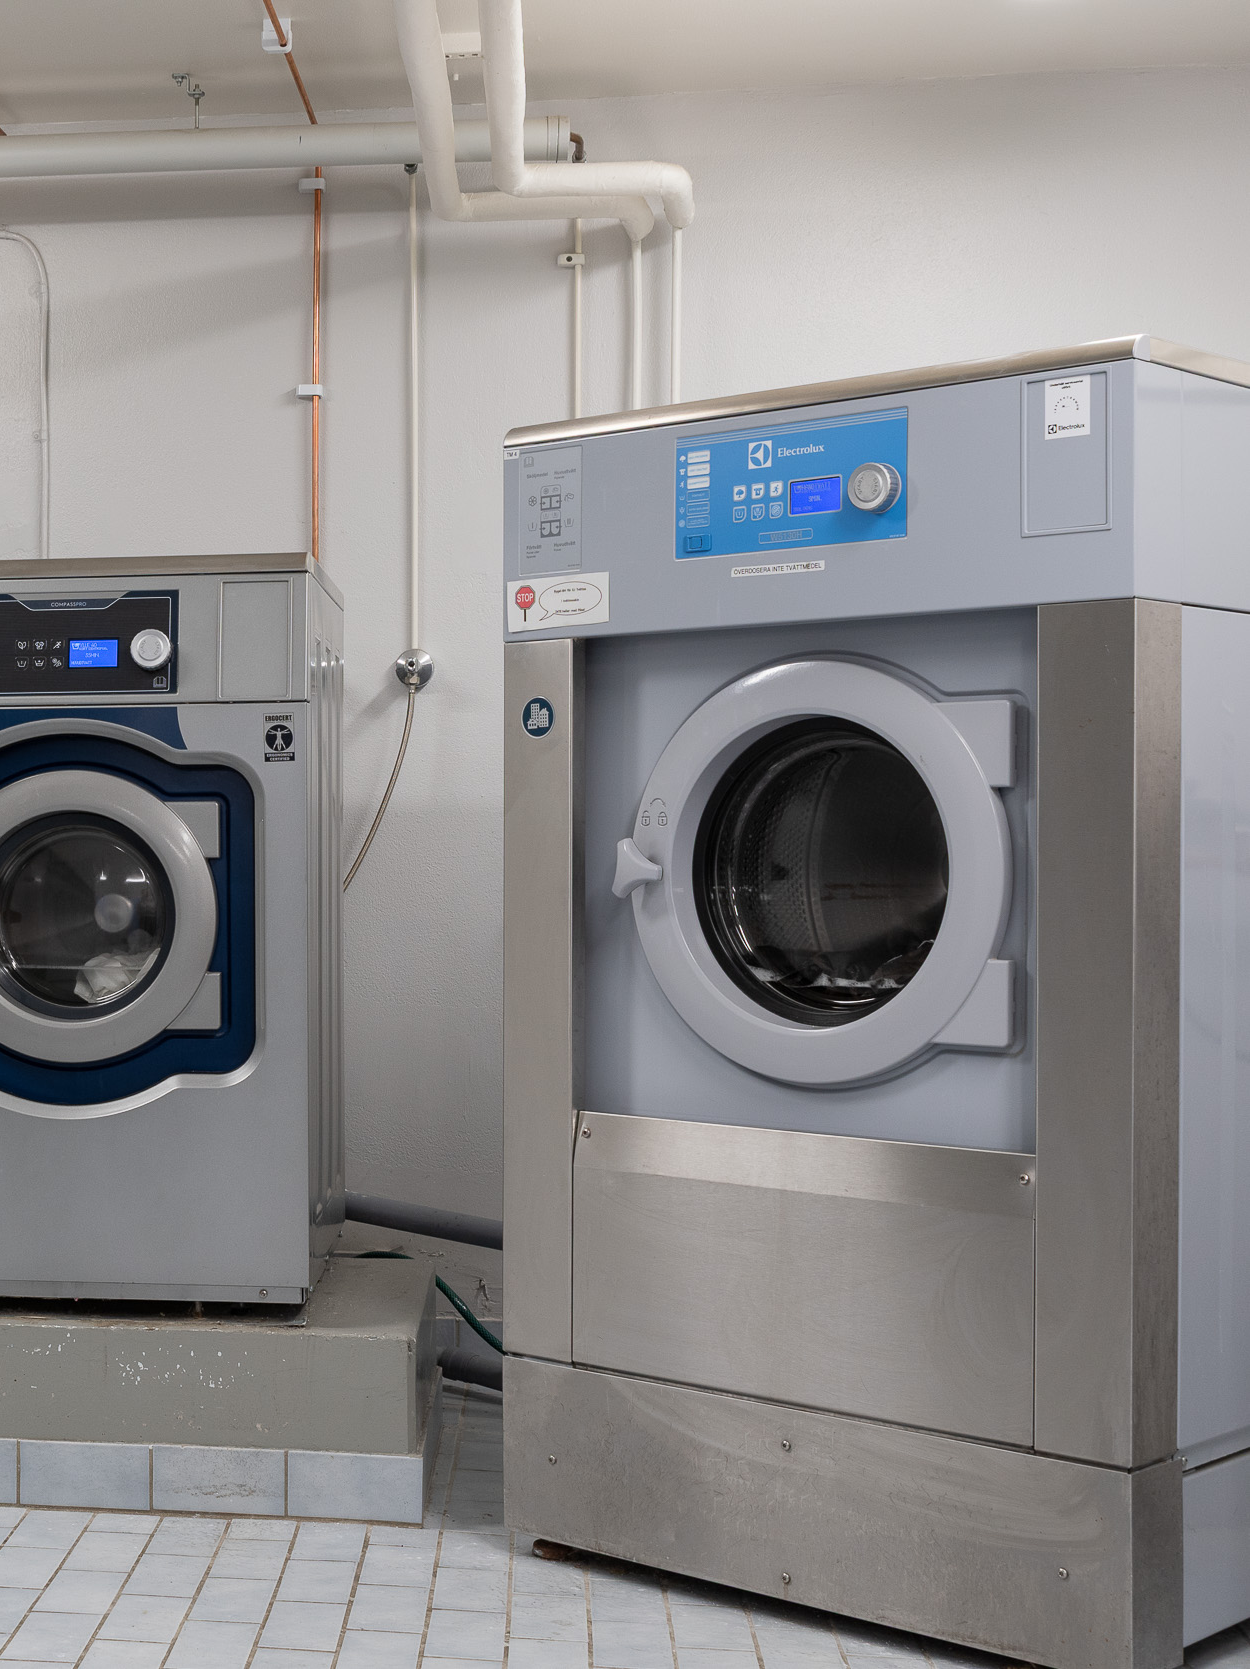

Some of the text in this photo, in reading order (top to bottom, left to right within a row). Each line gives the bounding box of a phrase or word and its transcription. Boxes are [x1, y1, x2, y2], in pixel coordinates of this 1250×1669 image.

[1058, 423, 1085, 431] Electrolux
[777, 443, 825, 458] Electrolux
[516, 592, 534, 603] STOP
[265, 714, 293, 722] ERGOCERT
